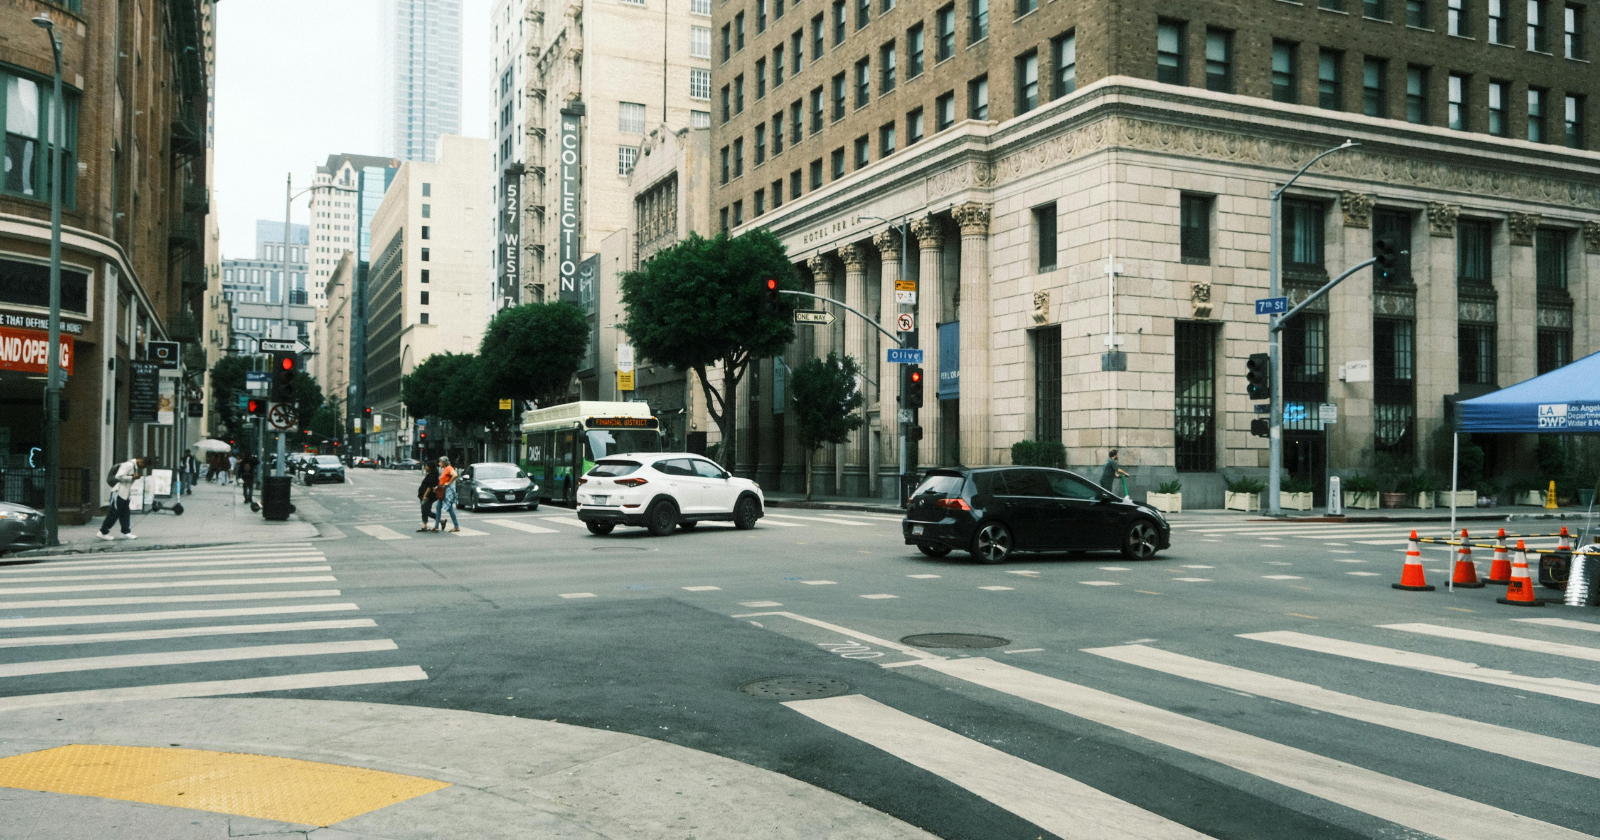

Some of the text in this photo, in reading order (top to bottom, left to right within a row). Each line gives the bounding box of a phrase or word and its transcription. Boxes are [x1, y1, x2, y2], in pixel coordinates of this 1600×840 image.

[564, 122, 576, 131] the
[507, 184, 518, 224] 527
[561, 134, 577, 292] COLLECTION
[804, 228, 828, 244] HOTEL
[832, 220, 846, 233] PER
[505, 234, 518, 286] WEST
[1258, 300, 1284, 312] 7th St
[6, 314, 24, 326] THAT
[797, 312, 810, 320] ONE
[1540, 406, 1554, 416] LA
[1540, 417, 1566, 427] DWP
[528, 446, 541, 462] DASH
